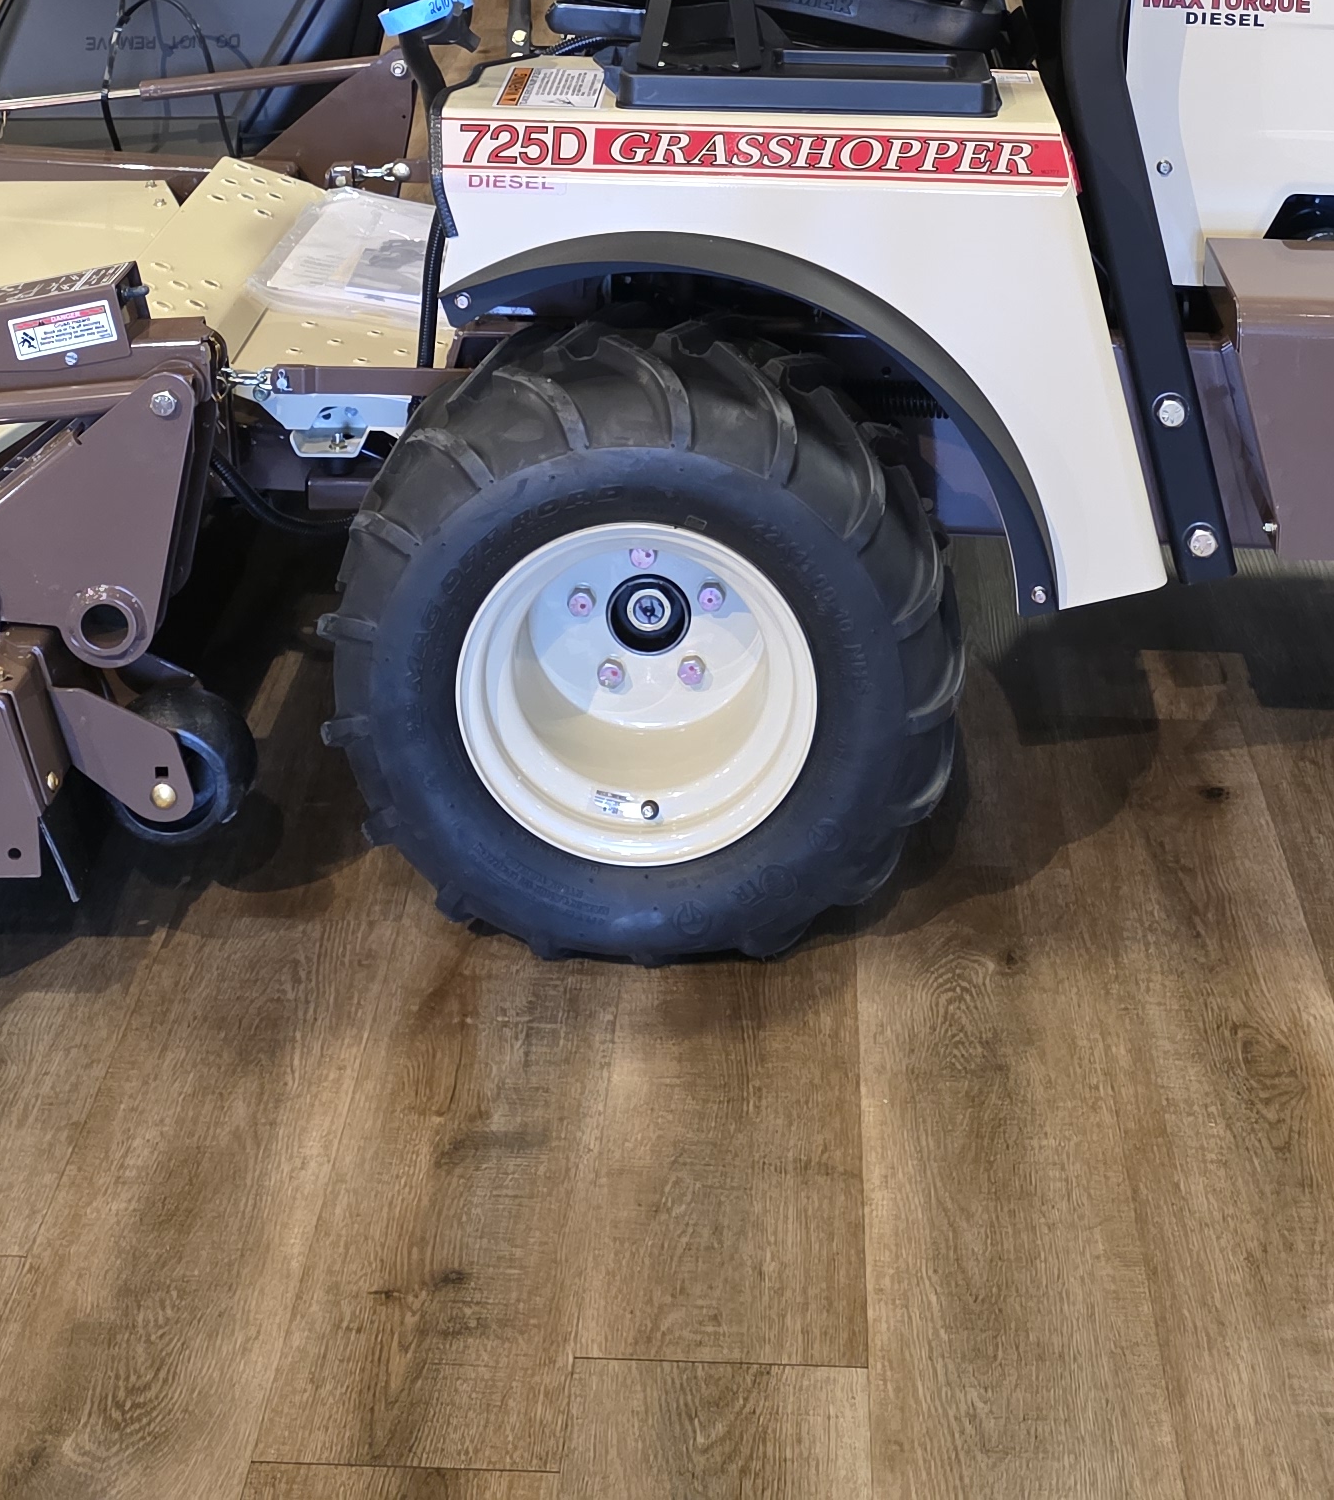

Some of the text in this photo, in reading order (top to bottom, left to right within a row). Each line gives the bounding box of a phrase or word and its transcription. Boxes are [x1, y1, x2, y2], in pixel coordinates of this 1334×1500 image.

[1185, 11, 1265, 27] DIESEL
[85, 35, 156, 51] REMVE
[458, 123, 588, 167] 725D
[607, 129, 1035, 175] GRASSHOPPER
[466, 173, 556, 191] DIESEL
[512, 484, 624, 529] ROAD
